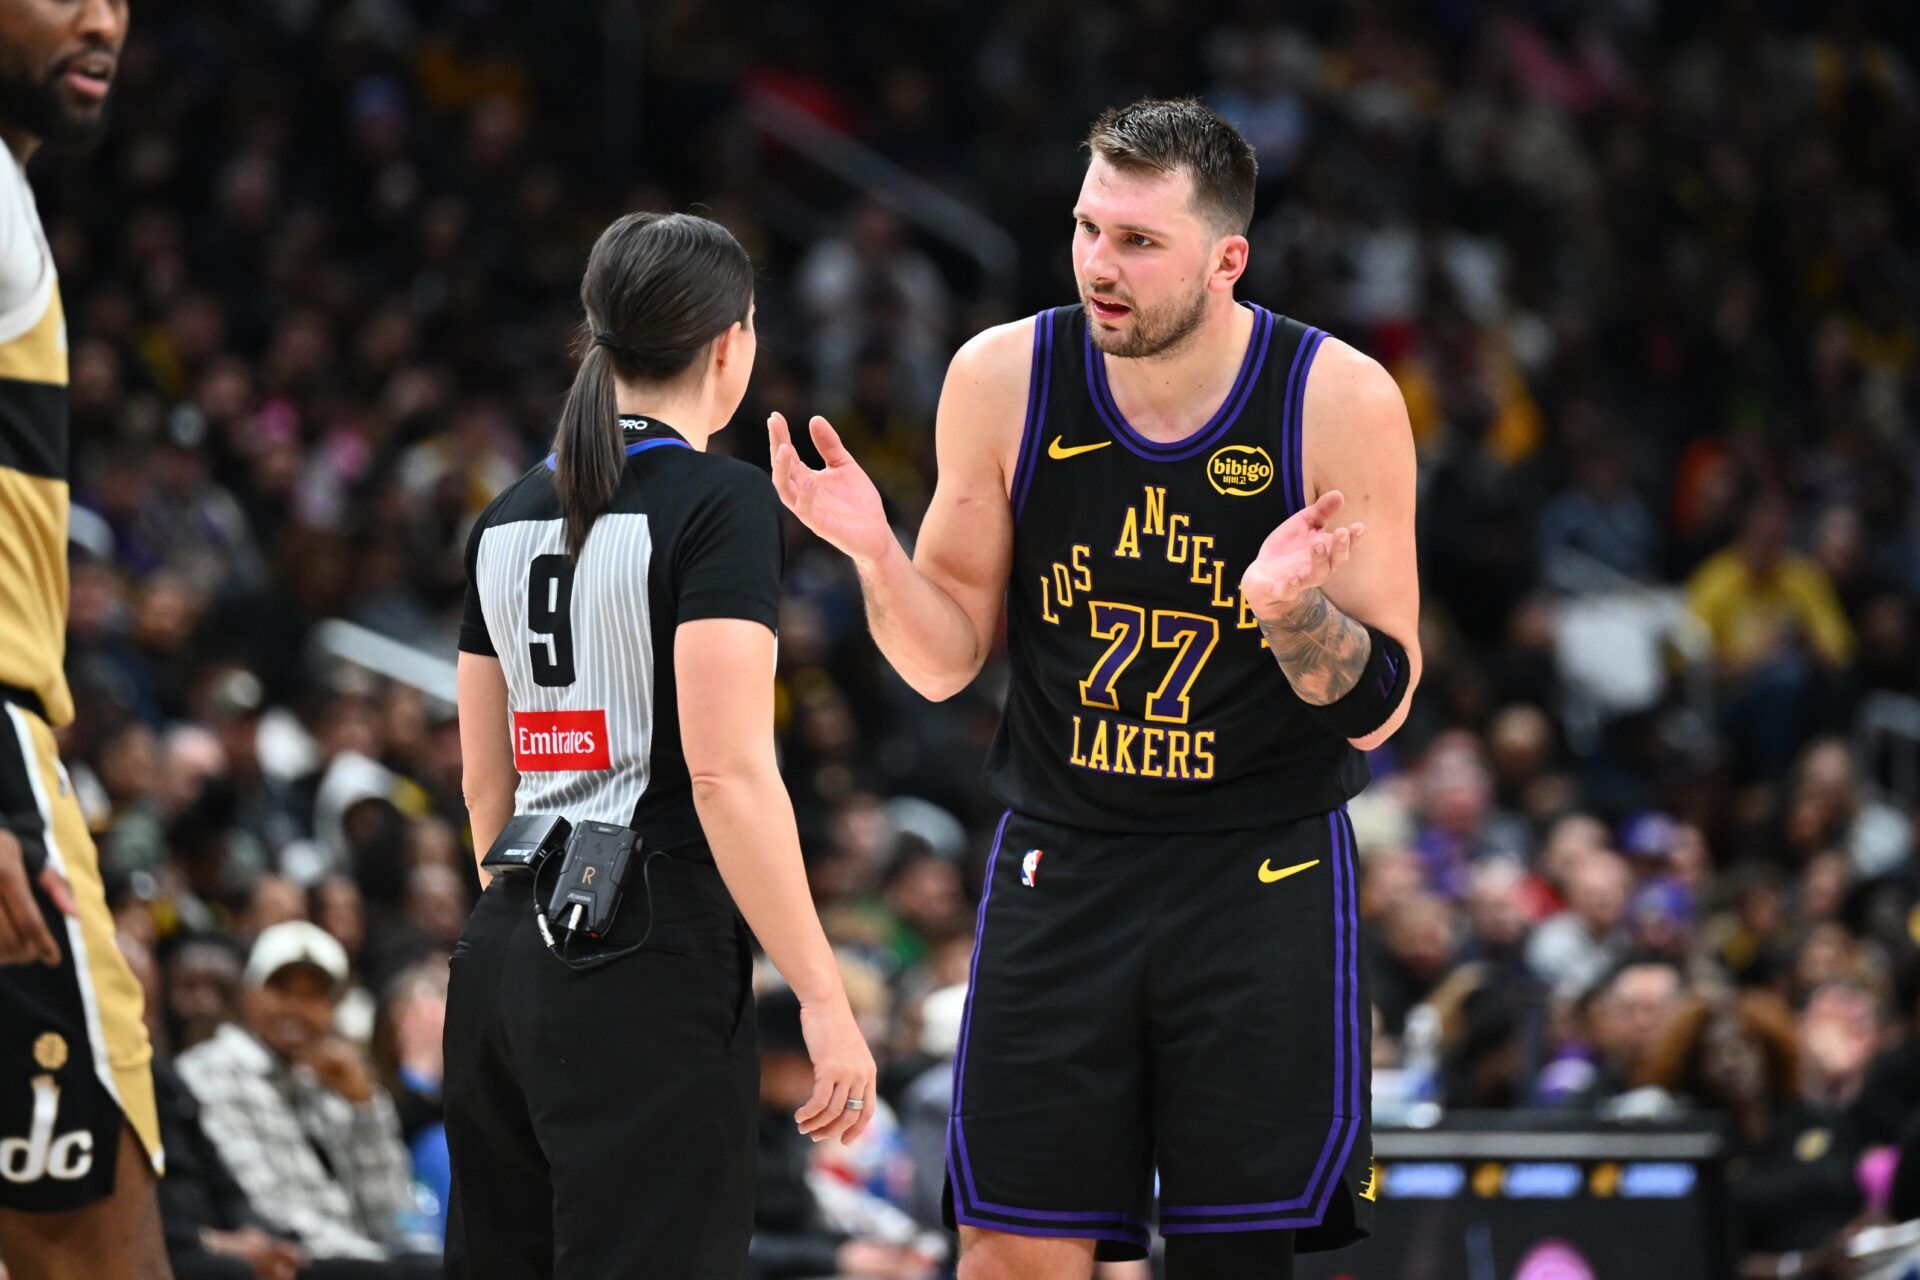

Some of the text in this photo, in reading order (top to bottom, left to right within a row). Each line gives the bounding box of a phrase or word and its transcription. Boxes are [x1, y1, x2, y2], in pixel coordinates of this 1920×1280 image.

[1214, 457, 1270, 482] bibigo
[1223, 475, 1246, 485] 비비고
[1041, 485, 1271, 648] LOS ANGELE
[528, 554, 577, 687] 9
[1079, 600, 1219, 724] 77
[519, 725, 596, 755] Emirates
[1071, 715, 1216, 779] LAKERS
[582, 866, 596, 885] R
